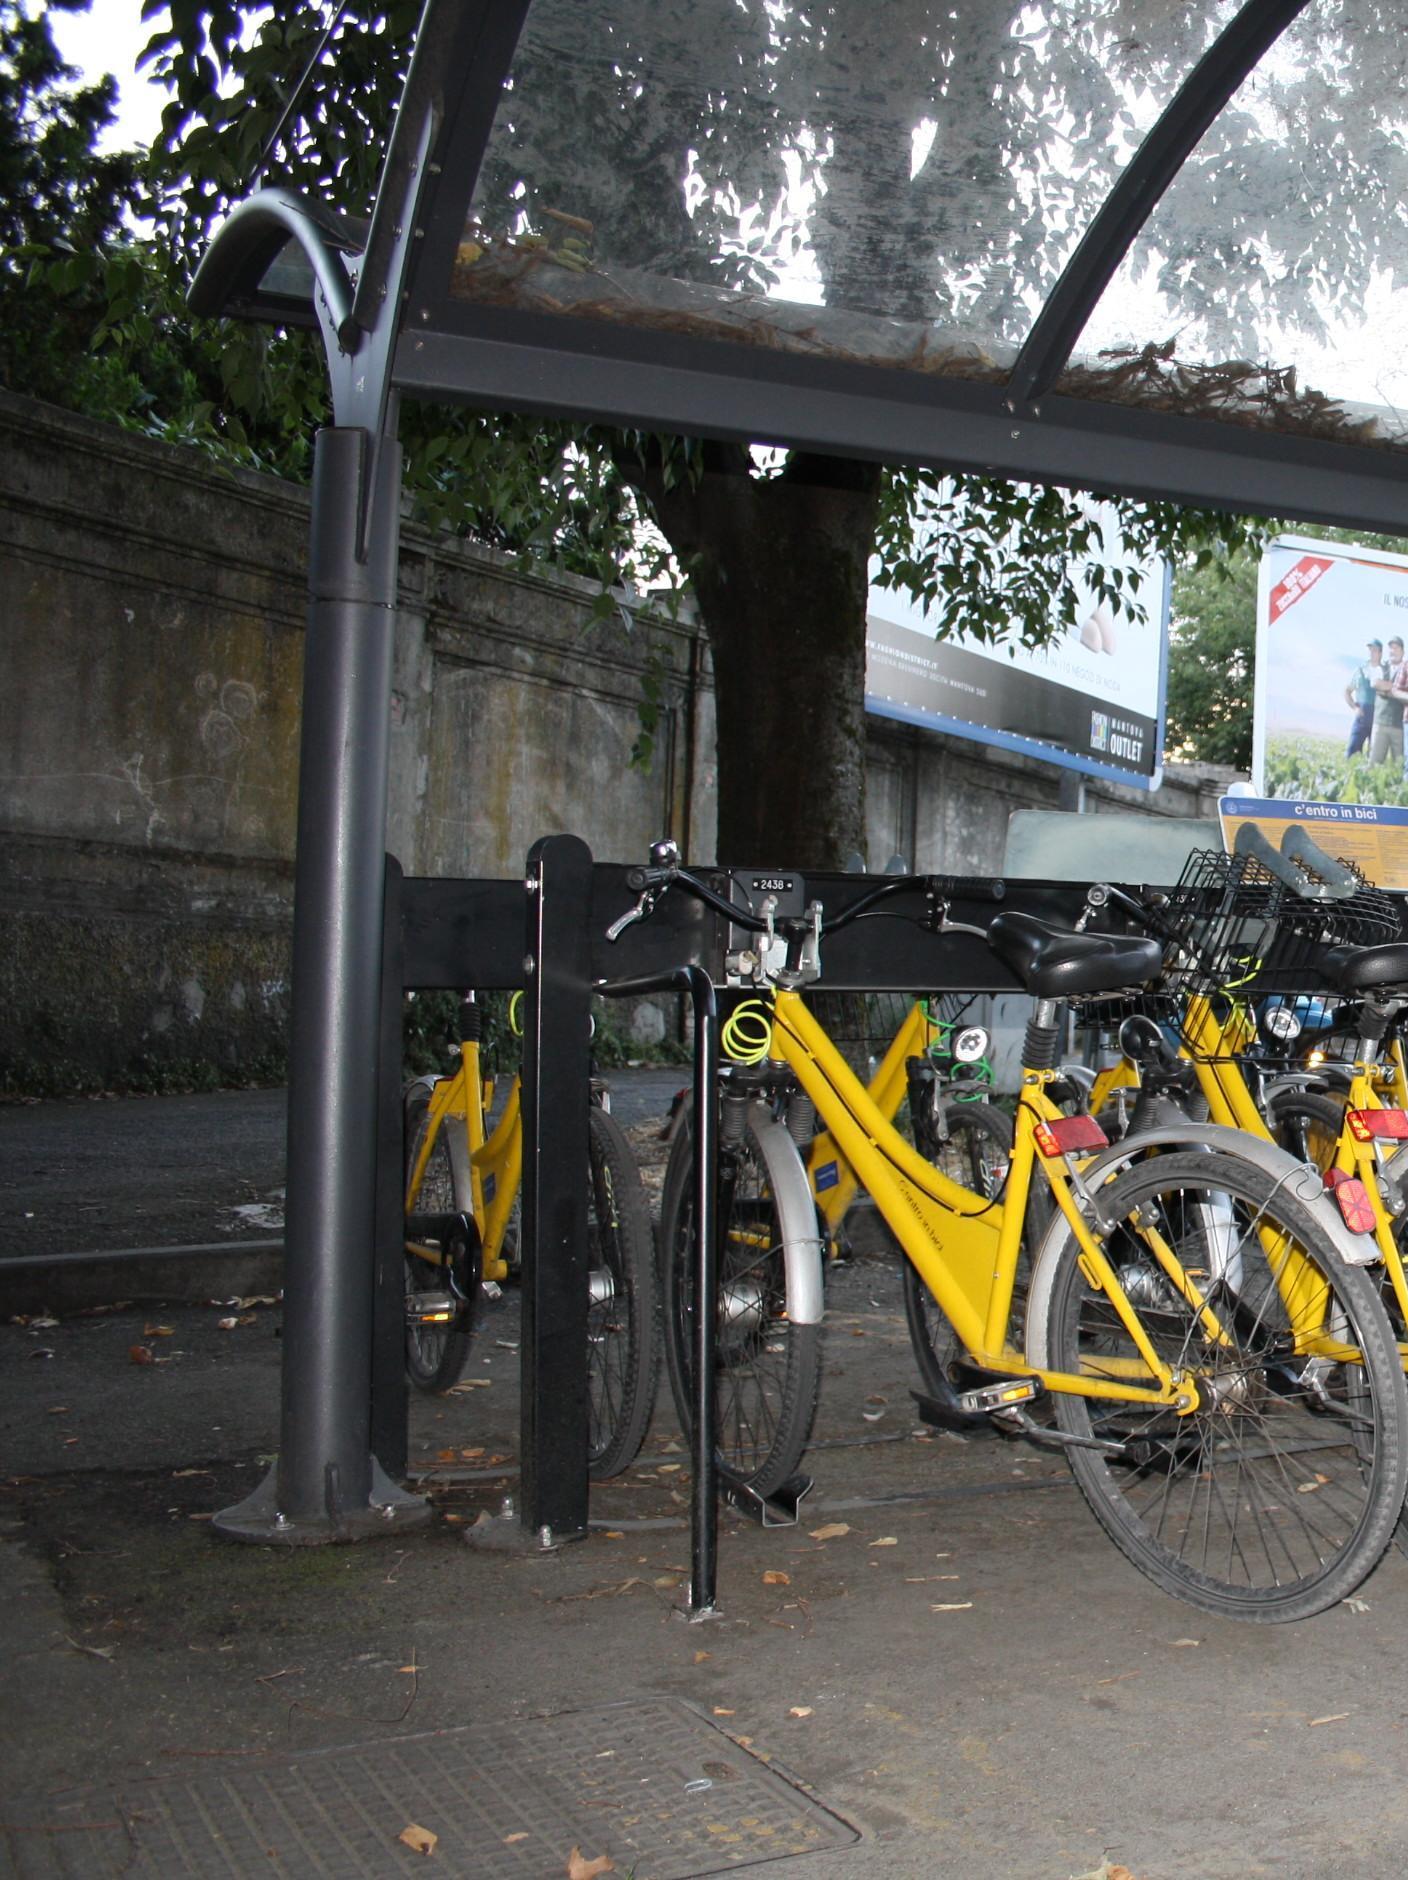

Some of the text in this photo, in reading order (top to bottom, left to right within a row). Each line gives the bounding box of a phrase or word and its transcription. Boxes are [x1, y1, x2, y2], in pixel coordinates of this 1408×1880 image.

[1383, 593, 1392, 606] IL
[1111, 718, 1144, 738] MANTOVA
[1110, 733, 1143, 763] OUTLET
[1295, 804, 1339, 818] c'entro
[1341, 807, 1353, 819] in
[1355, 808, 1378, 820] bici
[760, 879, 784, 890] 2438
